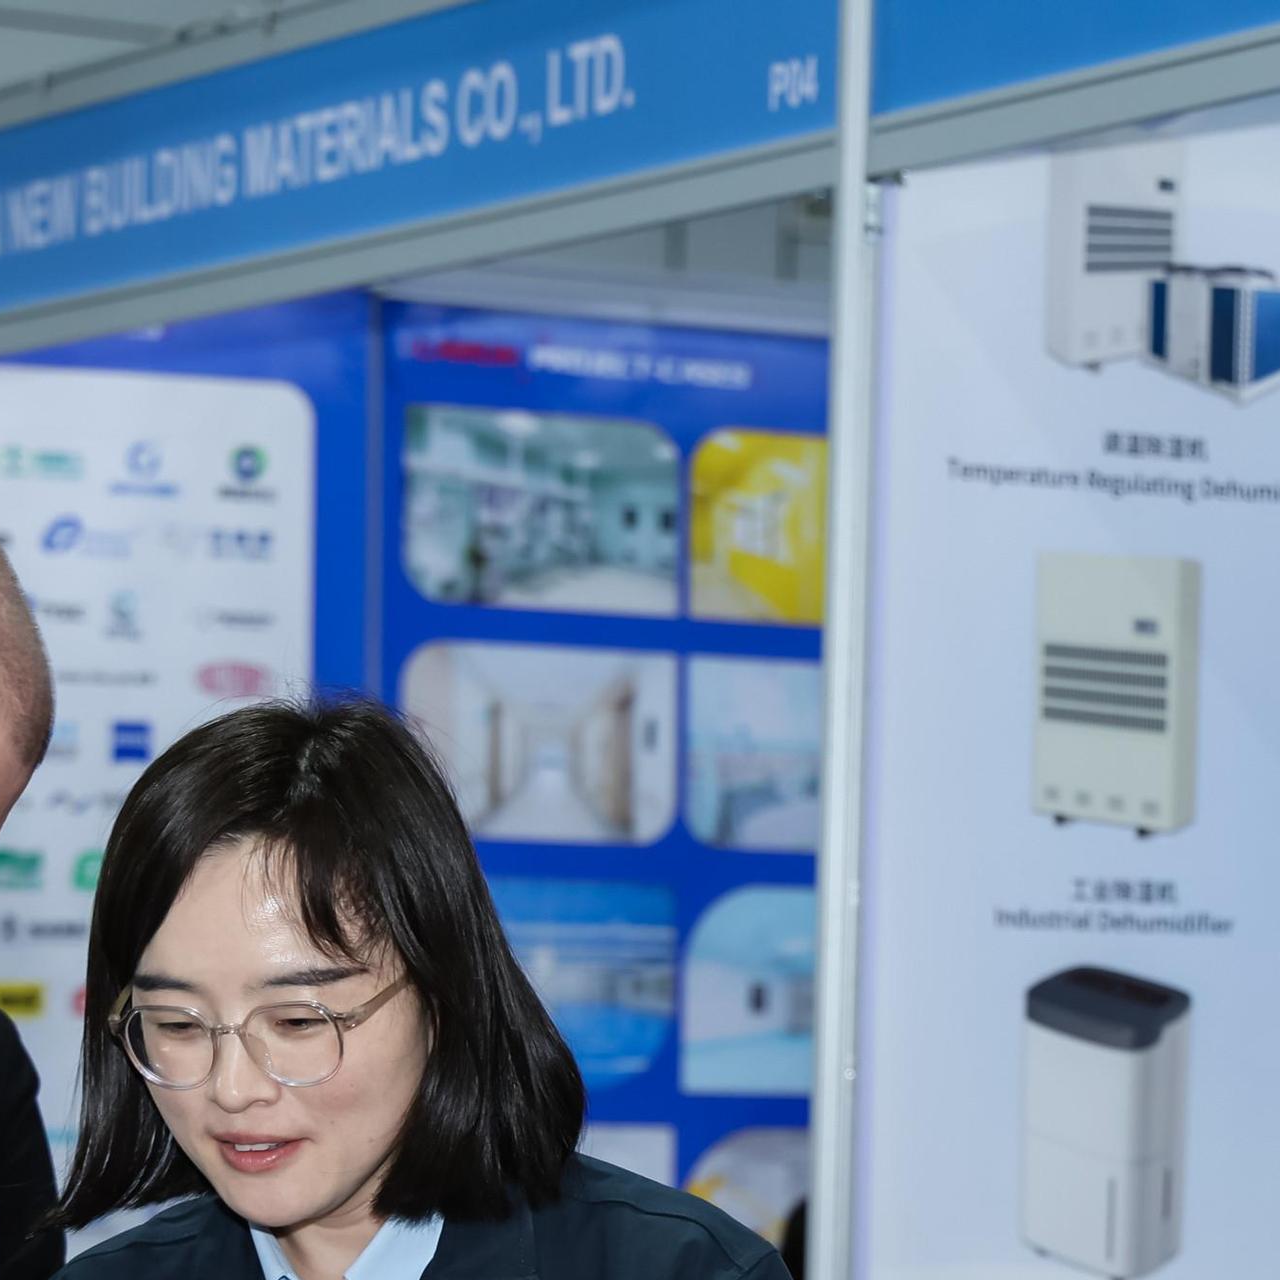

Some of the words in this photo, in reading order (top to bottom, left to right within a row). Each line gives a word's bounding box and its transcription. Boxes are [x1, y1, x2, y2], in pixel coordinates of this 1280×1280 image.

[769, 56, 819, 112] P04
[8, 174, 76, 251] NEW
[83, 134, 237, 238] BUILDING
[243, 82, 450, 198] MATERIALS
[947, 458, 1079, 489] Temperature
[1087, 470, 1194, 505] Regulating
[995, 908, 1091, 931] Industrial
[1098, 910, 1234, 934] Dehumidifier
